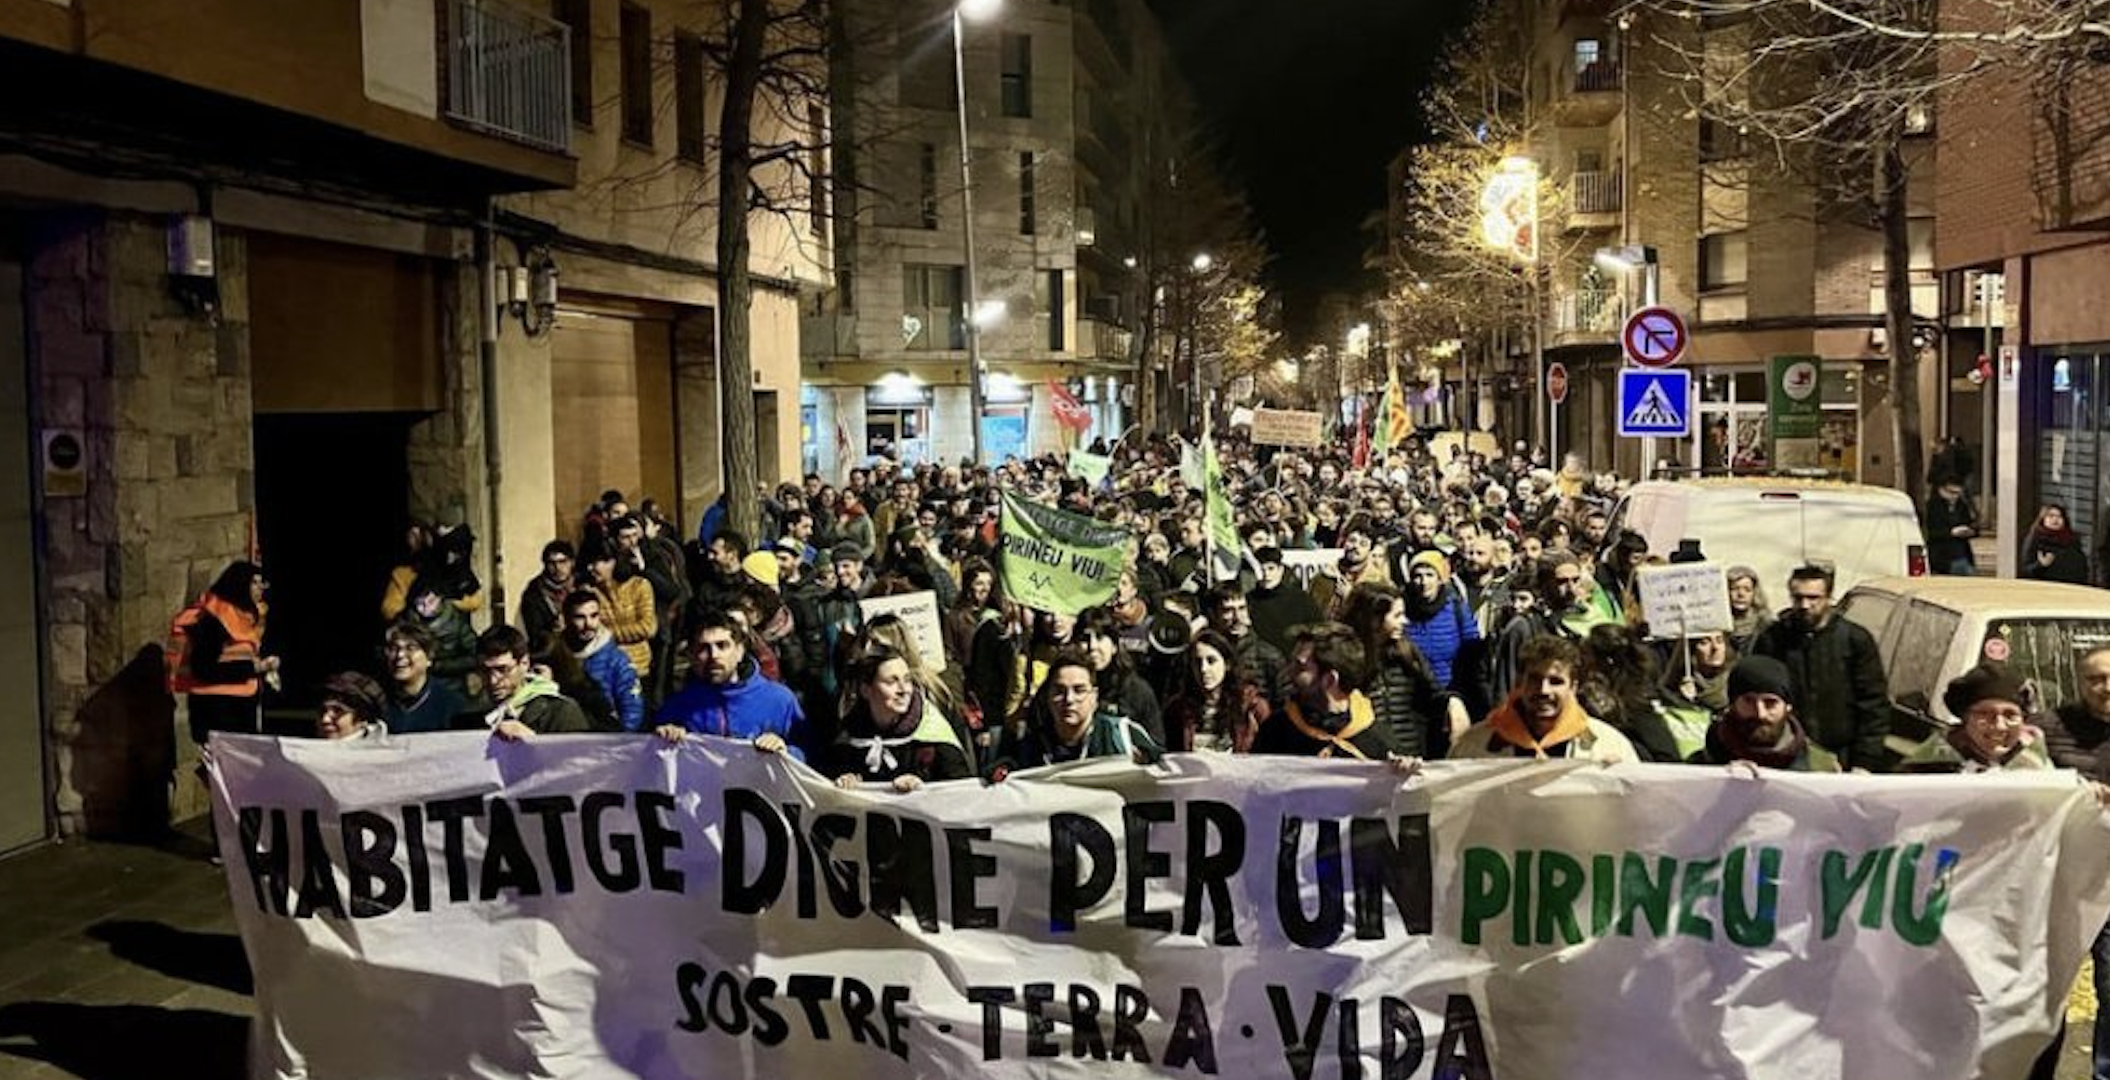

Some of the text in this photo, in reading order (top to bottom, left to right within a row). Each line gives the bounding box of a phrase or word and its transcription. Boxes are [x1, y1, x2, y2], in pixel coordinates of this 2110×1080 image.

[1002, 532, 1105, 581] PIRINEU VIU!
[238, 788, 1961, 949] HABITATGE DIGNE PER UN PIRINEU VIU
[676, 961, 910, 1063] SOSTRE
[967, 983, 1218, 1074] TERRA
[1267, 984, 1493, 1080] VIDA
